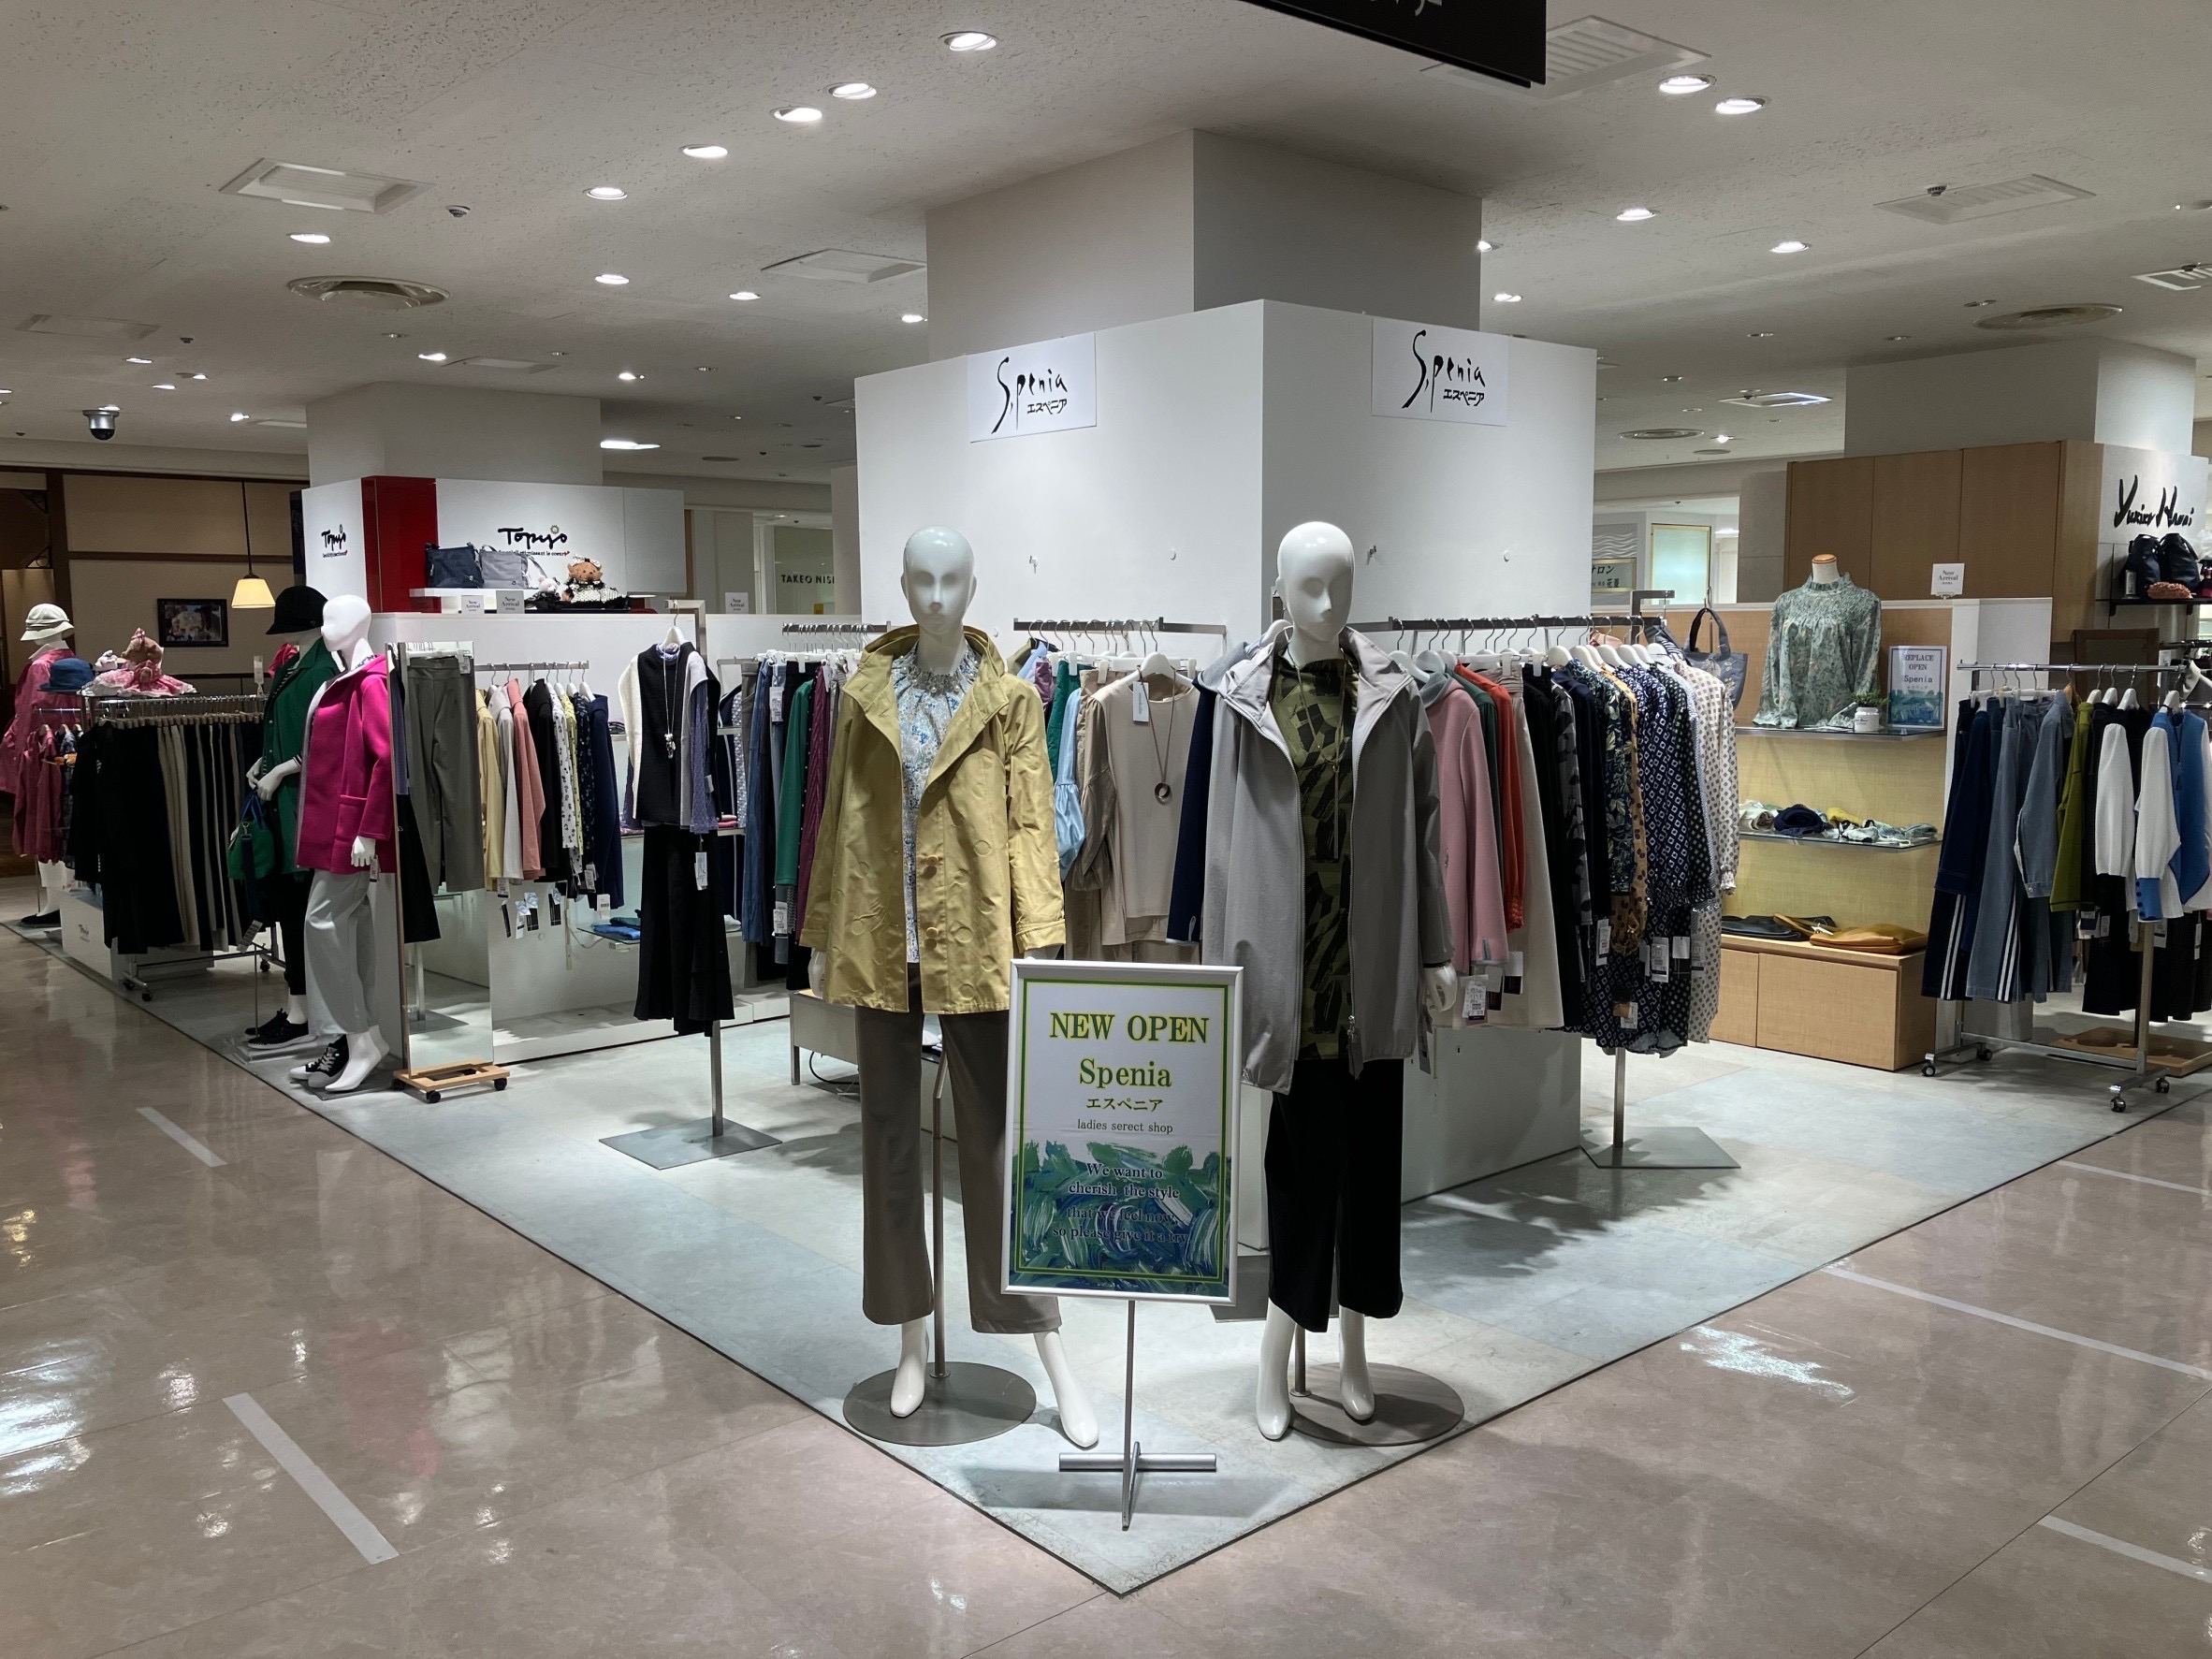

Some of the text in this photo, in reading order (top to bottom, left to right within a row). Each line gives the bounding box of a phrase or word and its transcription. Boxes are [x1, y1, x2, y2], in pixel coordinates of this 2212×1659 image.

[1402, 329, 1486, 413] Spenia
[991, 357, 1068, 434] Spenia
[1443, 389, 1485, 407] エスペニア
[1027, 399, 1068, 415] エスペニア
[780, 575, 812, 584] TAKEO
[1903, 675, 1933, 683] Spenia
[1049, 1012, 1210, 1044] NEW OPEN
[1079, 1057, 1172, 1089] Spenia
[1085, 1098, 1164, 1113] エスペニア
[1077, 1119, 1173, 1135] ladies serect shop
[1086, 1163, 1163, 1179] We want to
[1069, 1181, 1180, 1201] cherish the style
[1067, 1205, 1093, 1218] that
[1118, 1209, 1142, 1222] feel
[1053, 1228, 1067, 1236] so
[1070, 1226, 1111, 1241] please
[1113, 1229, 1141, 1243] give
[1144, 1230, 1156, 1242] it
[1157, 1233, 1166, 1242] a
